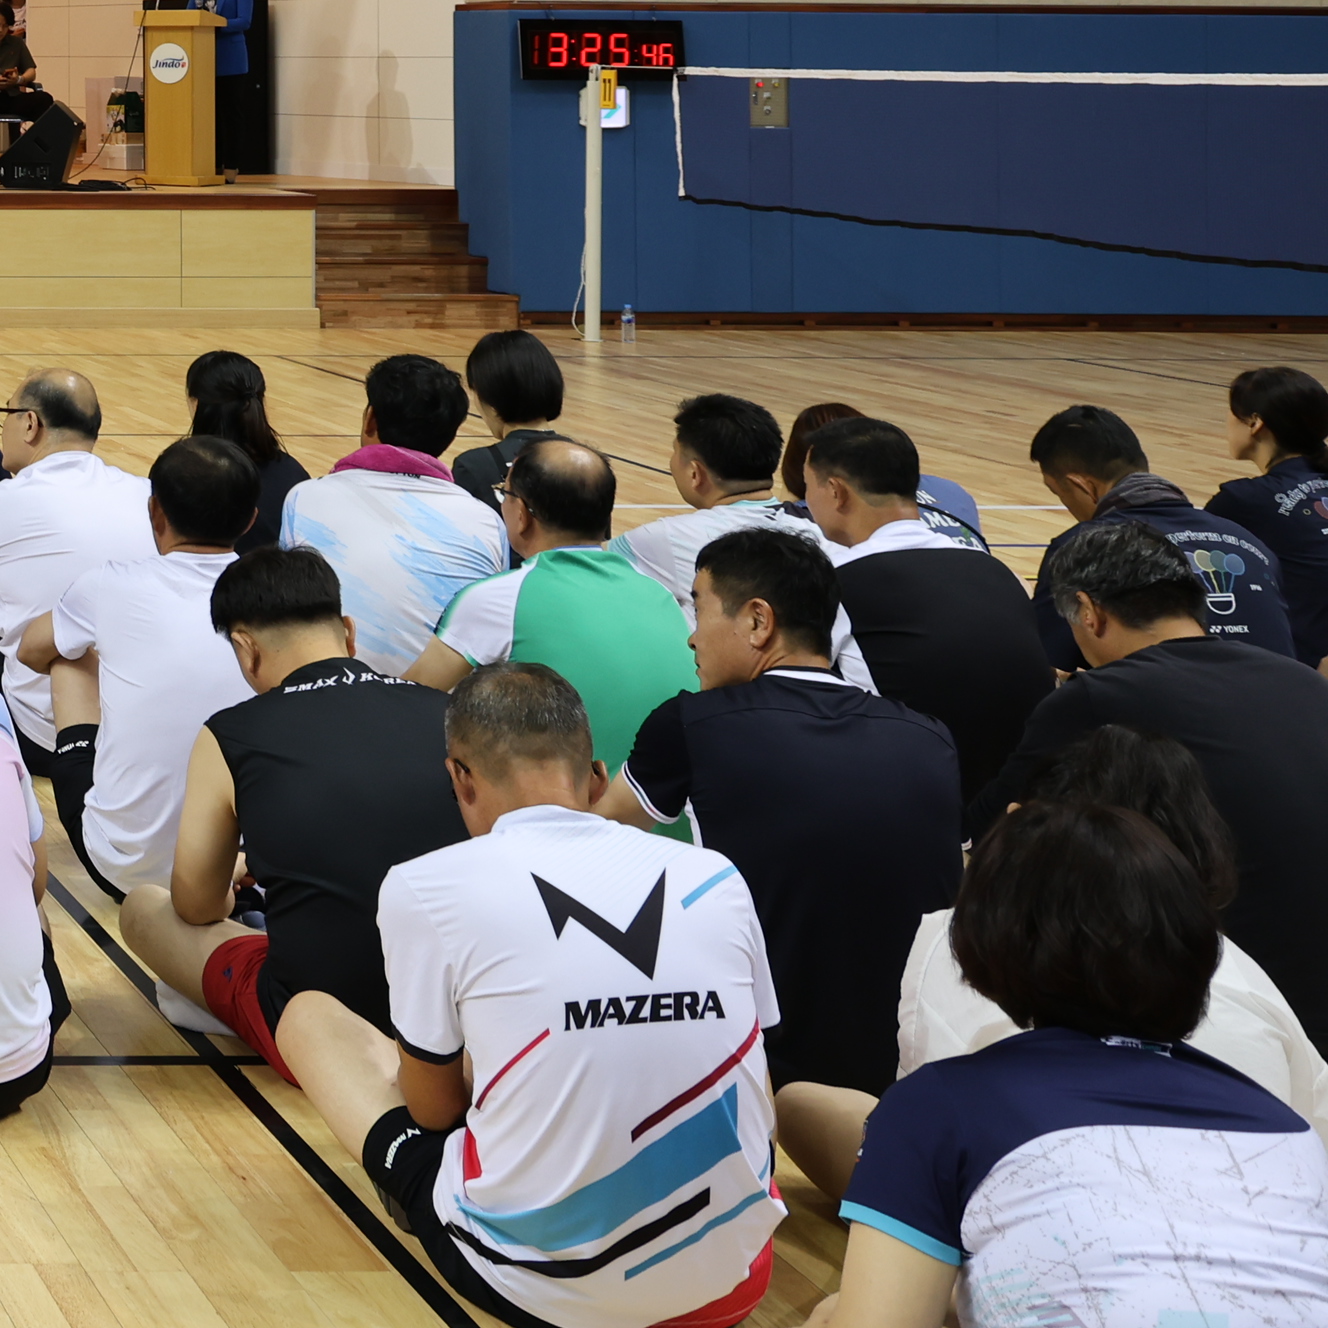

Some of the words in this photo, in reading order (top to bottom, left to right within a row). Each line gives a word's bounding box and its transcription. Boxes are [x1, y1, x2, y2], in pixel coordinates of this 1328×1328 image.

[152, 58, 181, 70] Jindo
[602, 78, 612, 102] 11
[1223, 625, 1250, 633] YONEX
[564, 990, 726, 1032] MAZERA
